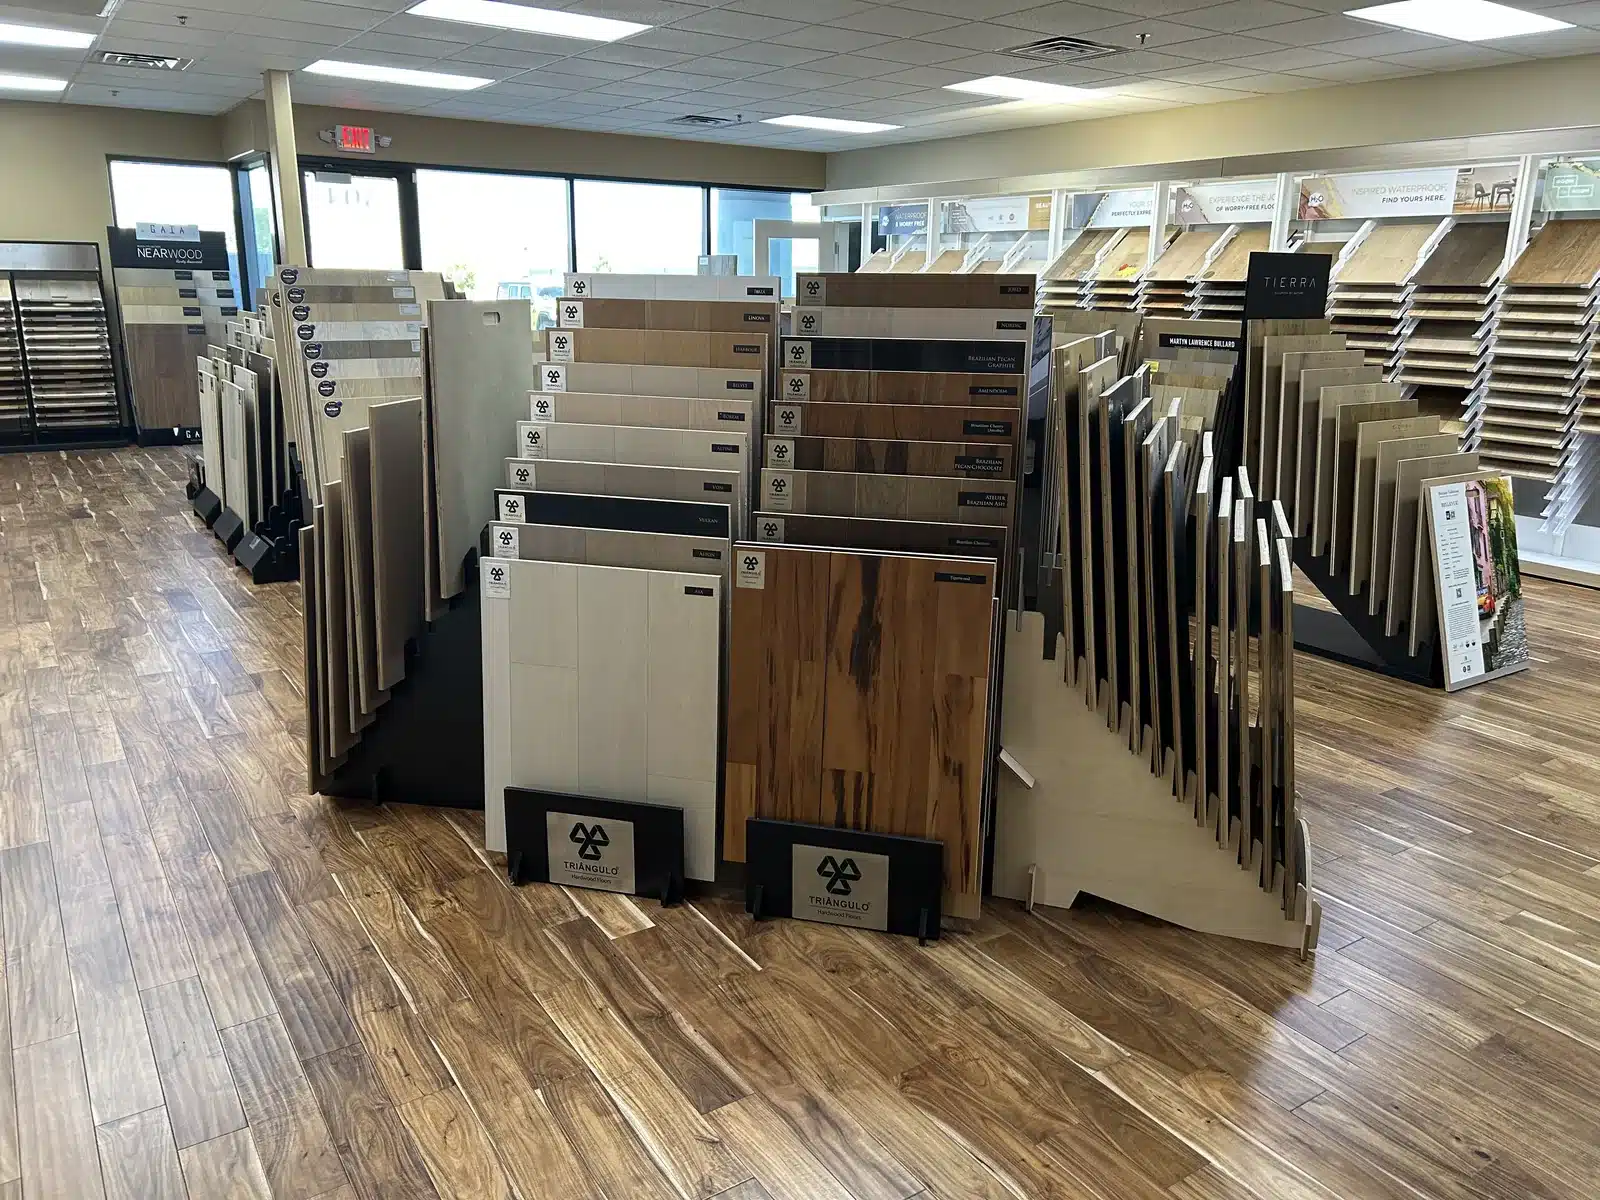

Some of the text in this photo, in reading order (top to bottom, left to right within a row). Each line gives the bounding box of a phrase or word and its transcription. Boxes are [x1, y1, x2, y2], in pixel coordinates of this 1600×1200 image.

[342, 126, 369, 149] EXIT
[1252, 194, 1264, 202] THE
[150, 224, 185, 234] GAIA
[137, 248, 203, 260] NEARWOOD
[1264, 276, 1316, 288] TIERRA
[1188, 339, 1213, 347] LAWRENCE
[1214, 340, 1235, 348] BULLARD
[817, 909, 844, 918] Hardwood
